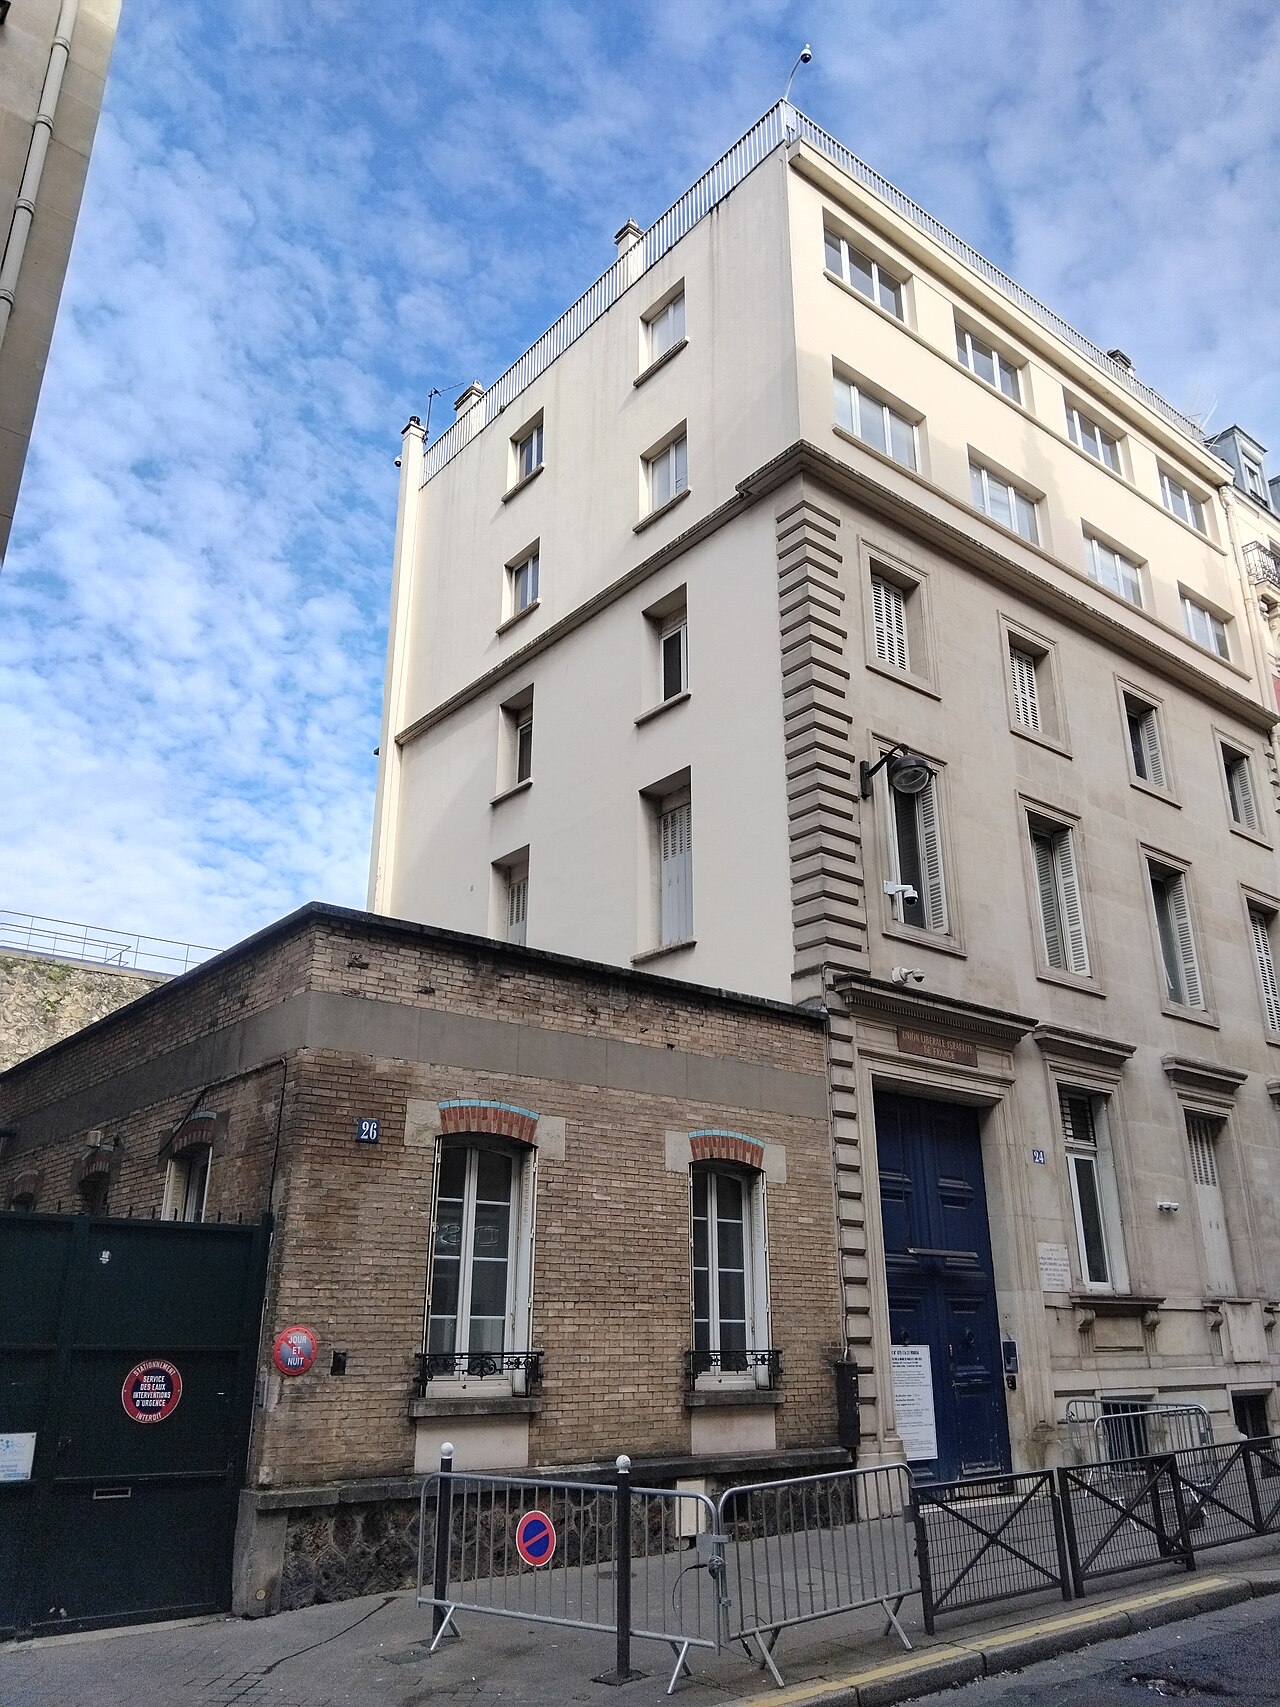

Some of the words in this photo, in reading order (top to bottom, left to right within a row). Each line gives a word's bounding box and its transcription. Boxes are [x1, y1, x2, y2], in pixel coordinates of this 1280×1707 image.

[933, 1047, 956, 1060] FRANCE
[360, 1121, 378, 1140] 26
[1033, 1150, 1044, 1164] 24
[288, 1335, 307, 1344] JOUR
[292, 1346, 302, 1355] ET
[287, 1357, 304, 1366] NUIT
[133, 1361, 176, 1377] STATIONNEMENT
[142, 1375, 165, 1383] SERVICE
[140, 1383, 151, 1391] DES
[151, 1383, 166, 1391] EAUX
[132, 1391, 171, 1399] INTERVENTIONS
[135, 1399, 166, 1407] D'URGENCE
[136, 1411, 162, 1421] INTERDIT
